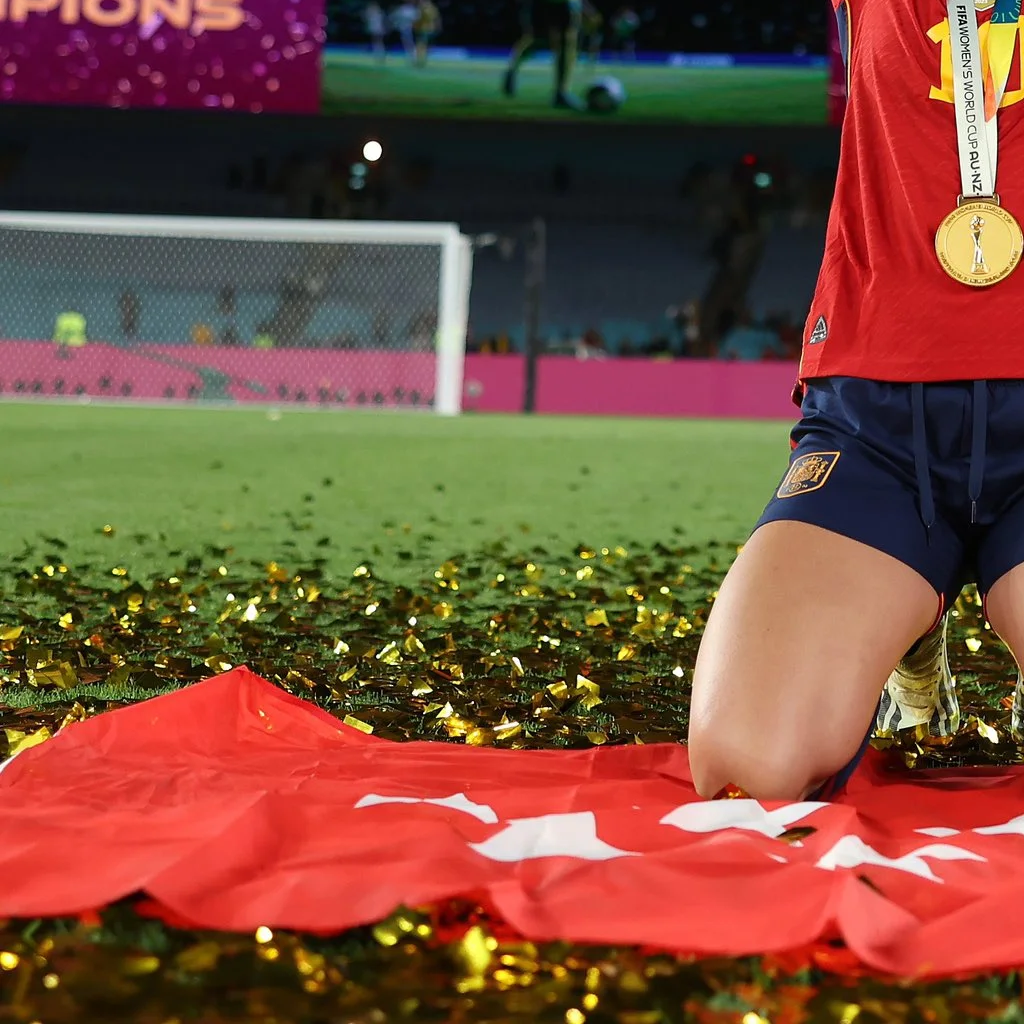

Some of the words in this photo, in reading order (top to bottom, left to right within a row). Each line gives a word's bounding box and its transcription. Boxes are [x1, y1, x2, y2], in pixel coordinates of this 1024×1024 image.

[956, 5, 968, 27] FIFA
[959, 26, 973, 79] WOMEN'S
[963, 80, 976, 124] WORLD
[967, 124, 978, 149] CUP
